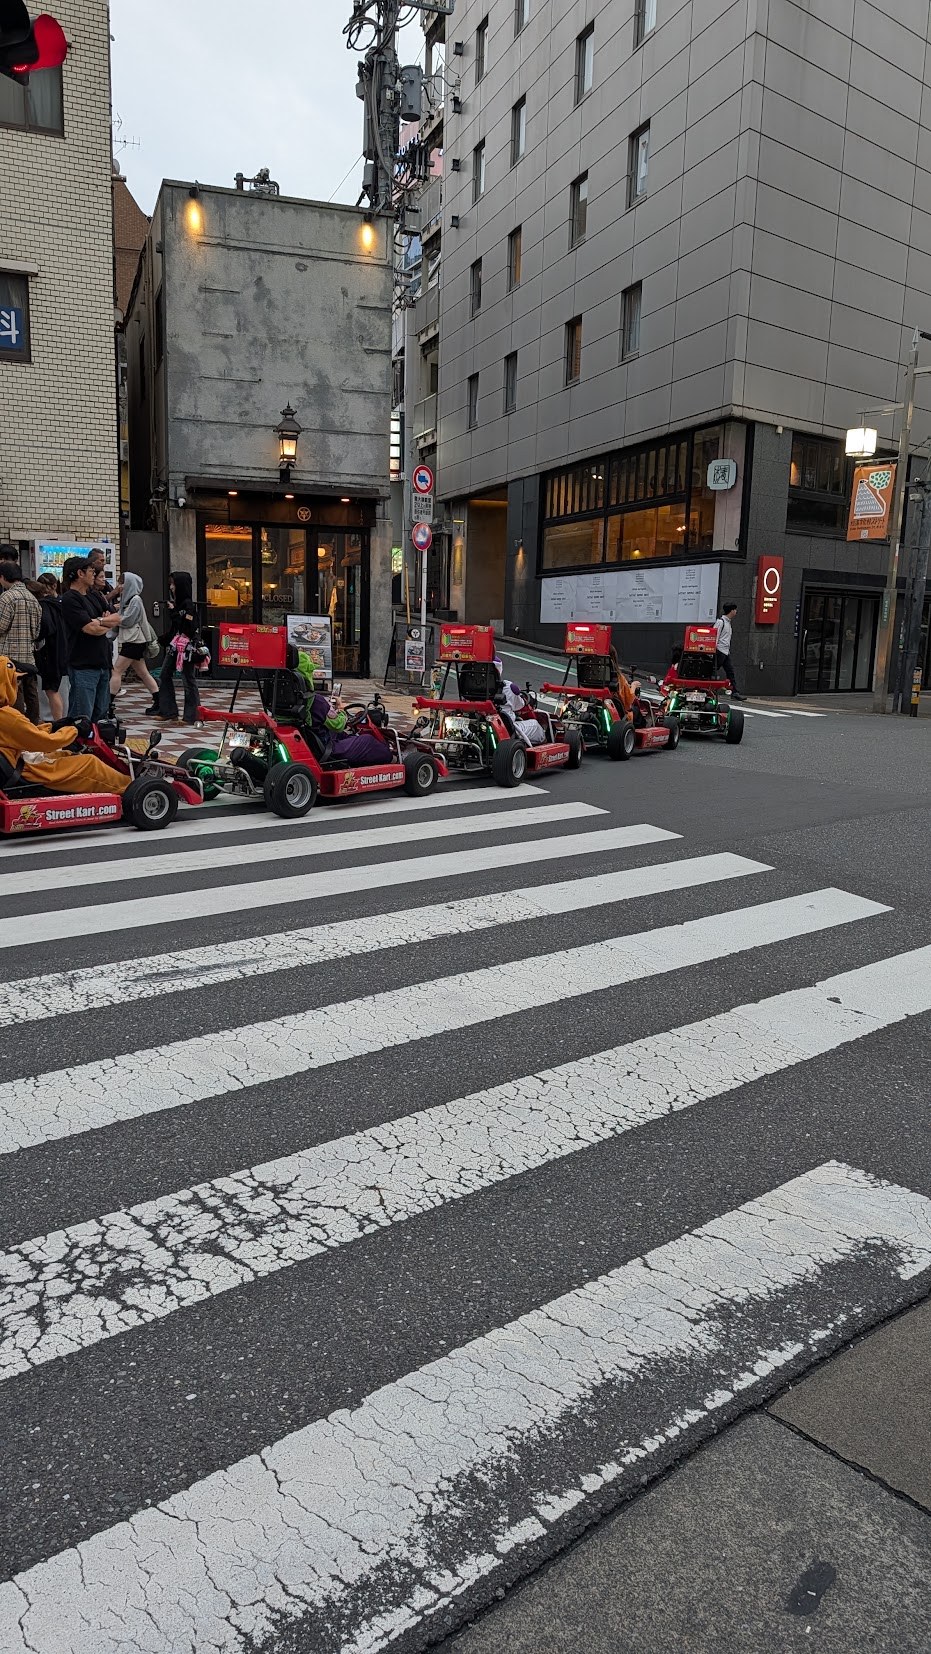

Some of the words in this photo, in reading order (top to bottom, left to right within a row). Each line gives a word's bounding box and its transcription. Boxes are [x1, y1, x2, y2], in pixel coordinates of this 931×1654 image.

[263, 594, 293, 603] CLOSED
[360, 775, 378, 785] Street
[379, 773, 391, 783] Kart
[46, 809, 75, 821] Street
[76, 806, 95, 818] Kart
[96, 804, 117, 816] .com
